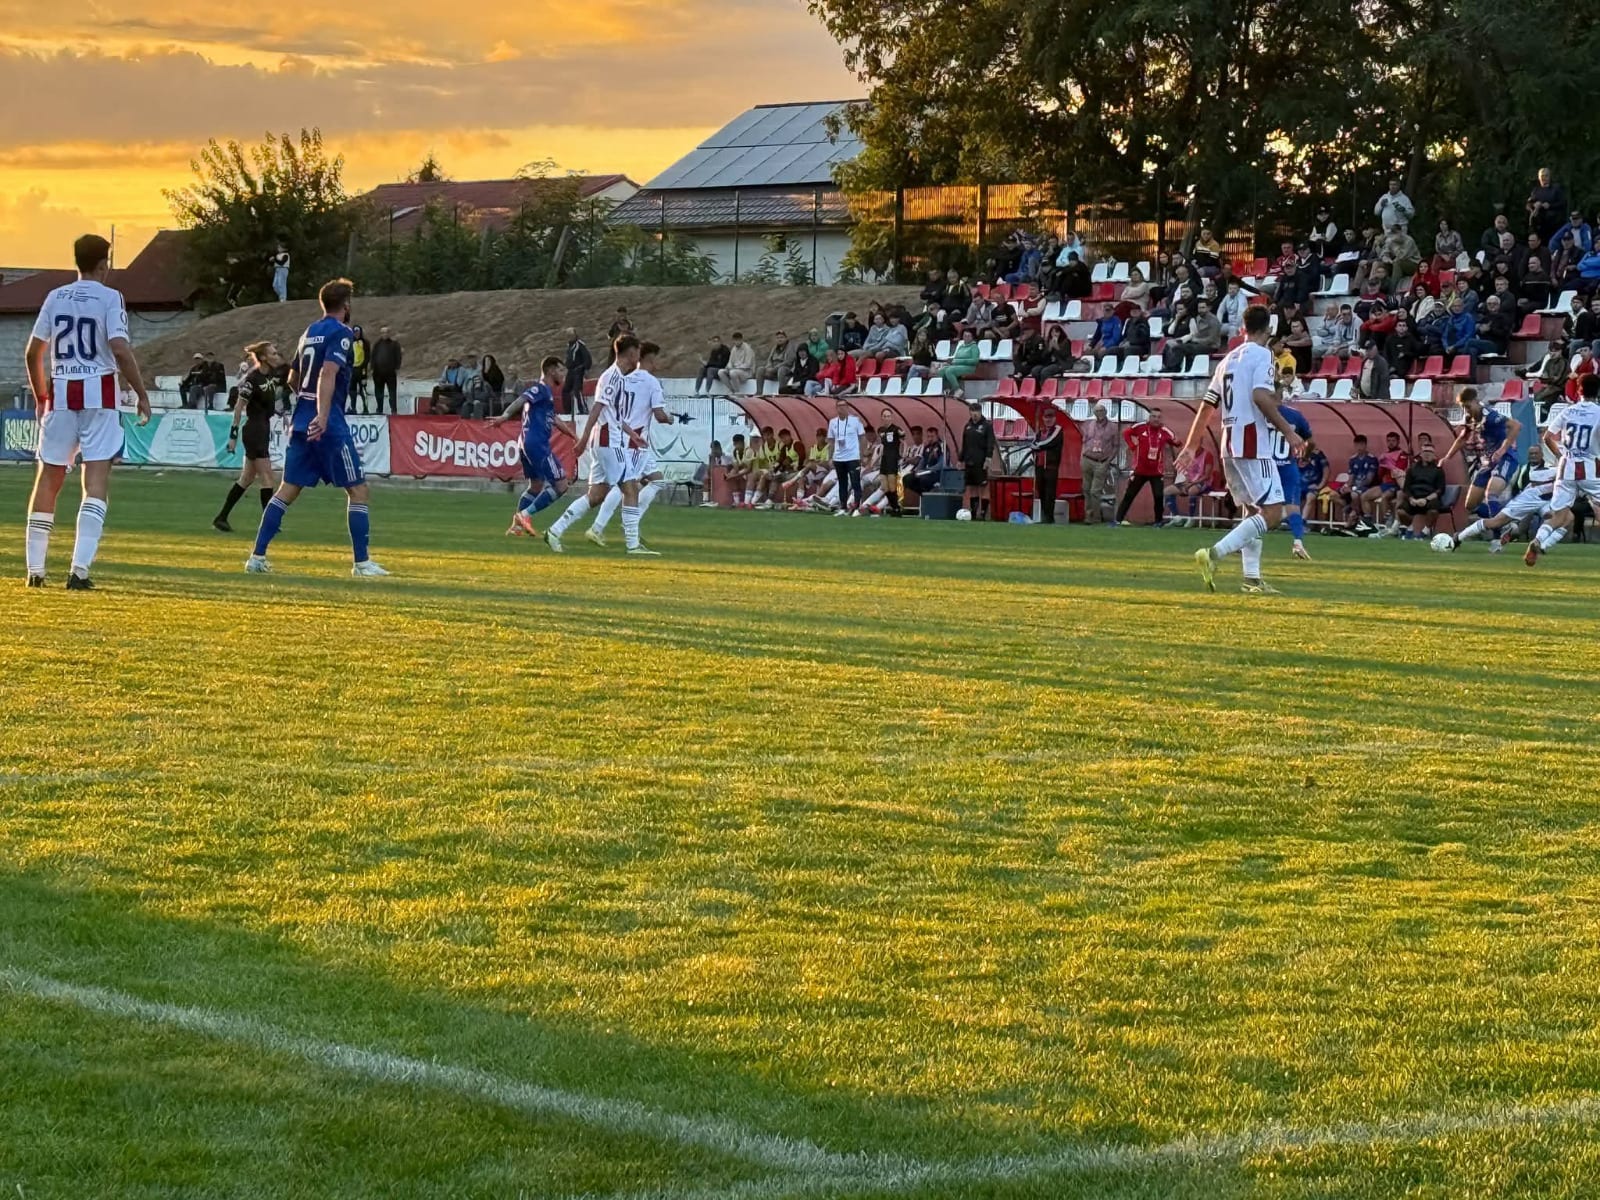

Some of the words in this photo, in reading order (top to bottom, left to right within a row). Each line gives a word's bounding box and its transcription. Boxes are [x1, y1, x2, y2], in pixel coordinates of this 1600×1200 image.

[55, 314, 96, 360] 20
[350, 424, 380, 443] ROD
[414, 430, 520, 468] SUPERSCO
[1565, 422, 1594, 451] 30
